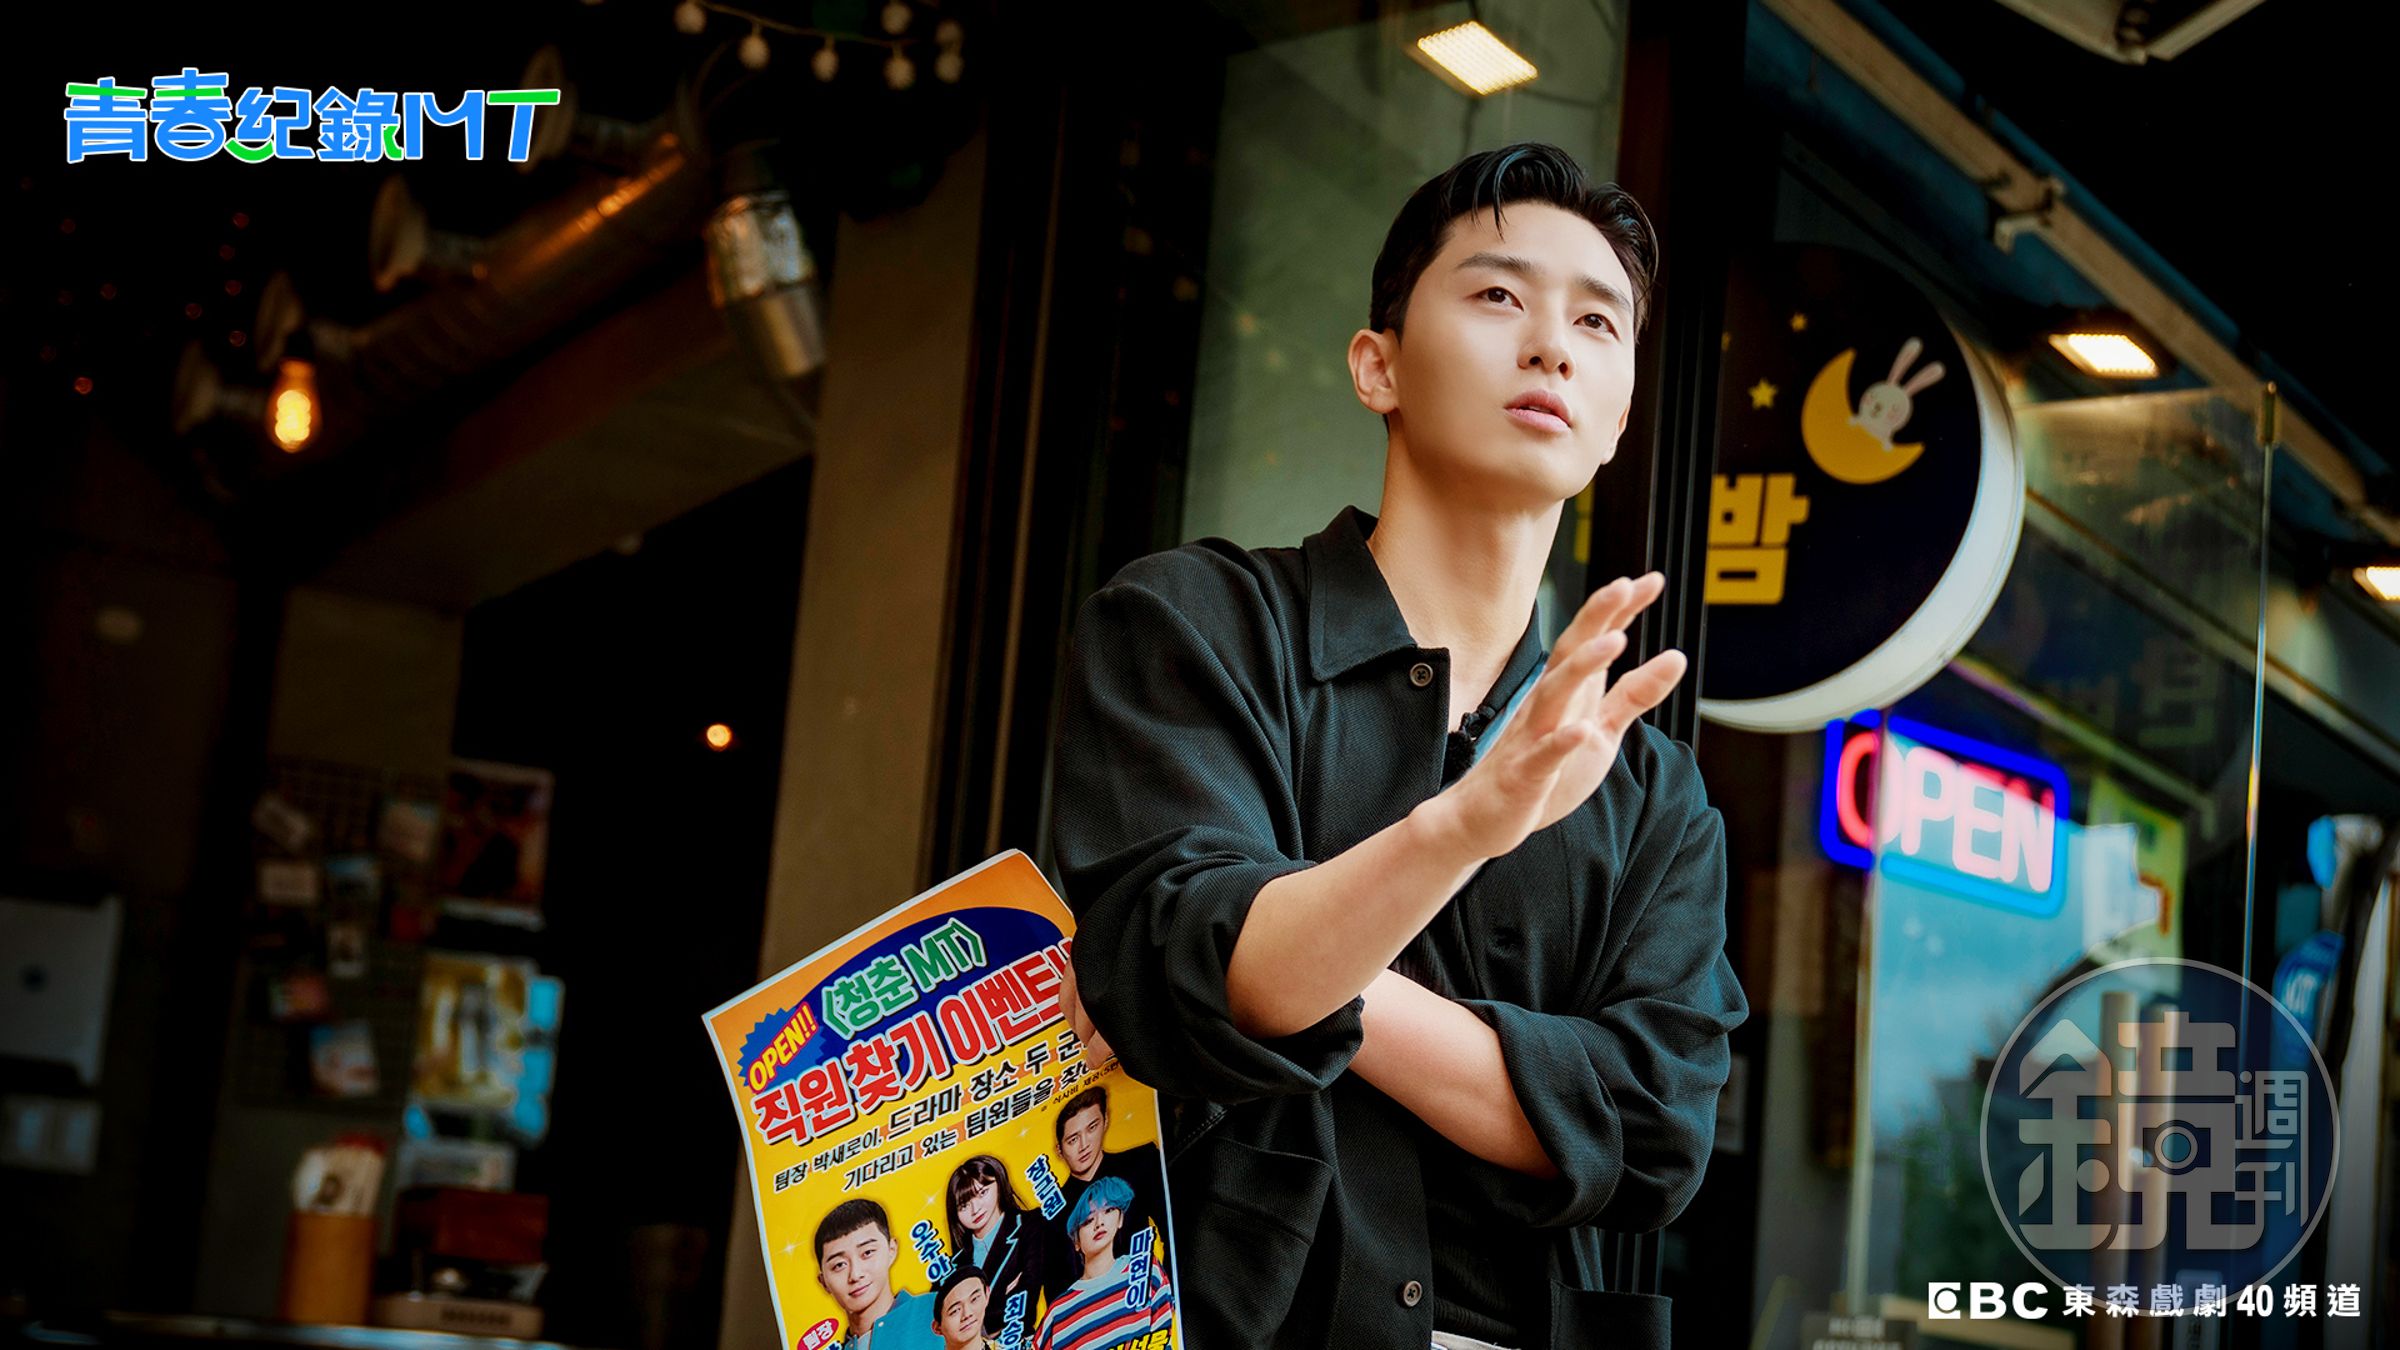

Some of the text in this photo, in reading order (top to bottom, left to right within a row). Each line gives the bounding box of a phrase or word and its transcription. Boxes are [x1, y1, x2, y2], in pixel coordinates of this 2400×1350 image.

[1704, 473, 1810, 604] 밤
[1836, 731, 2056, 893] OPEN
[747, 1002, 818, 1093] OPEN!!
[757, 1060, 852, 1143] 직원
[844, 1013, 948, 1111] 찾기
[773, 1163, 808, 1192] 팀장
[888, 1084, 962, 1140] 드라마
[970, 1060, 1018, 1102] 장소
[1025, 1042, 1050, 1076] 두
[1058, 1029, 1087, 1062] 군
[843, 1144, 914, 1191] 기다리고
[921, 1130, 958, 1158] 있는
[965, 1078, 1054, 1139] 팀원들을
[1025, 1155, 1066, 1219] 장근원
[911, 1221, 951, 1281] 오수아
[1126, 1228, 1154, 1309] 마현이
[1003, 1290, 1027, 1350] 최승
